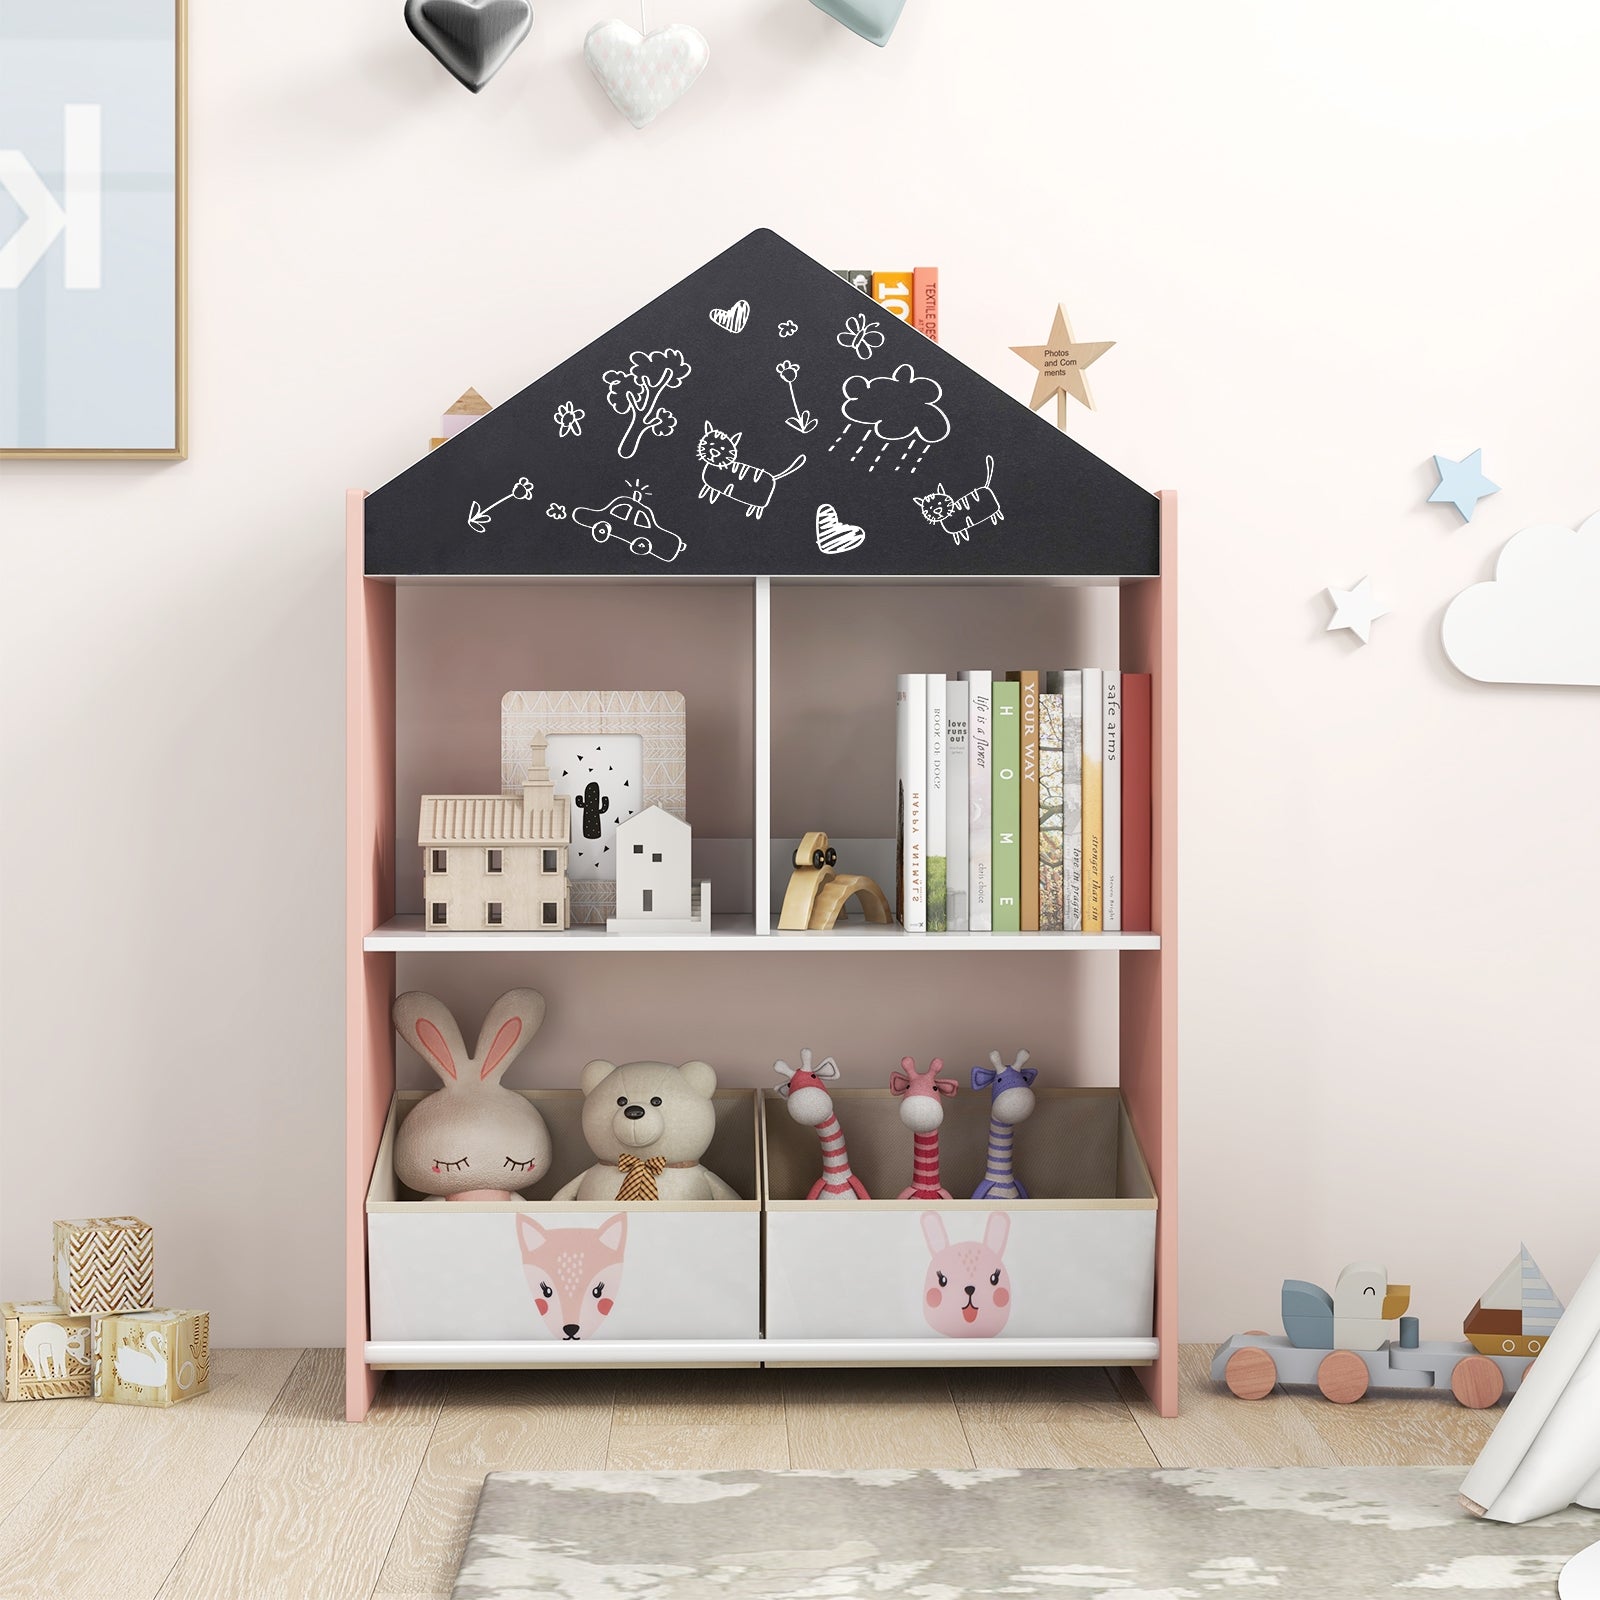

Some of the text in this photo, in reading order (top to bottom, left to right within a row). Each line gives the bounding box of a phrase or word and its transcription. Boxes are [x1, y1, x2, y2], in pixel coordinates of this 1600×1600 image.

[925, 282, 937, 320] TEXTILE
[1044, 349, 1070, 358] Photos
[1044, 359, 1058, 367] and
[1044, 369, 1067, 377] ments
[948, 719, 967, 728] love
[973, 695, 990, 769] life is a flower
[1024, 681, 1036, 783] YOUR WAY
[1107, 684, 1121, 762] safe arms
[1000, 705, 1014, 906] HOME
[1089, 834, 1099, 876] stronger
[978, 862, 987, 904] chris choice
[1071, 847, 1082, 920] love in prague
[1092, 880, 1101, 903] than
